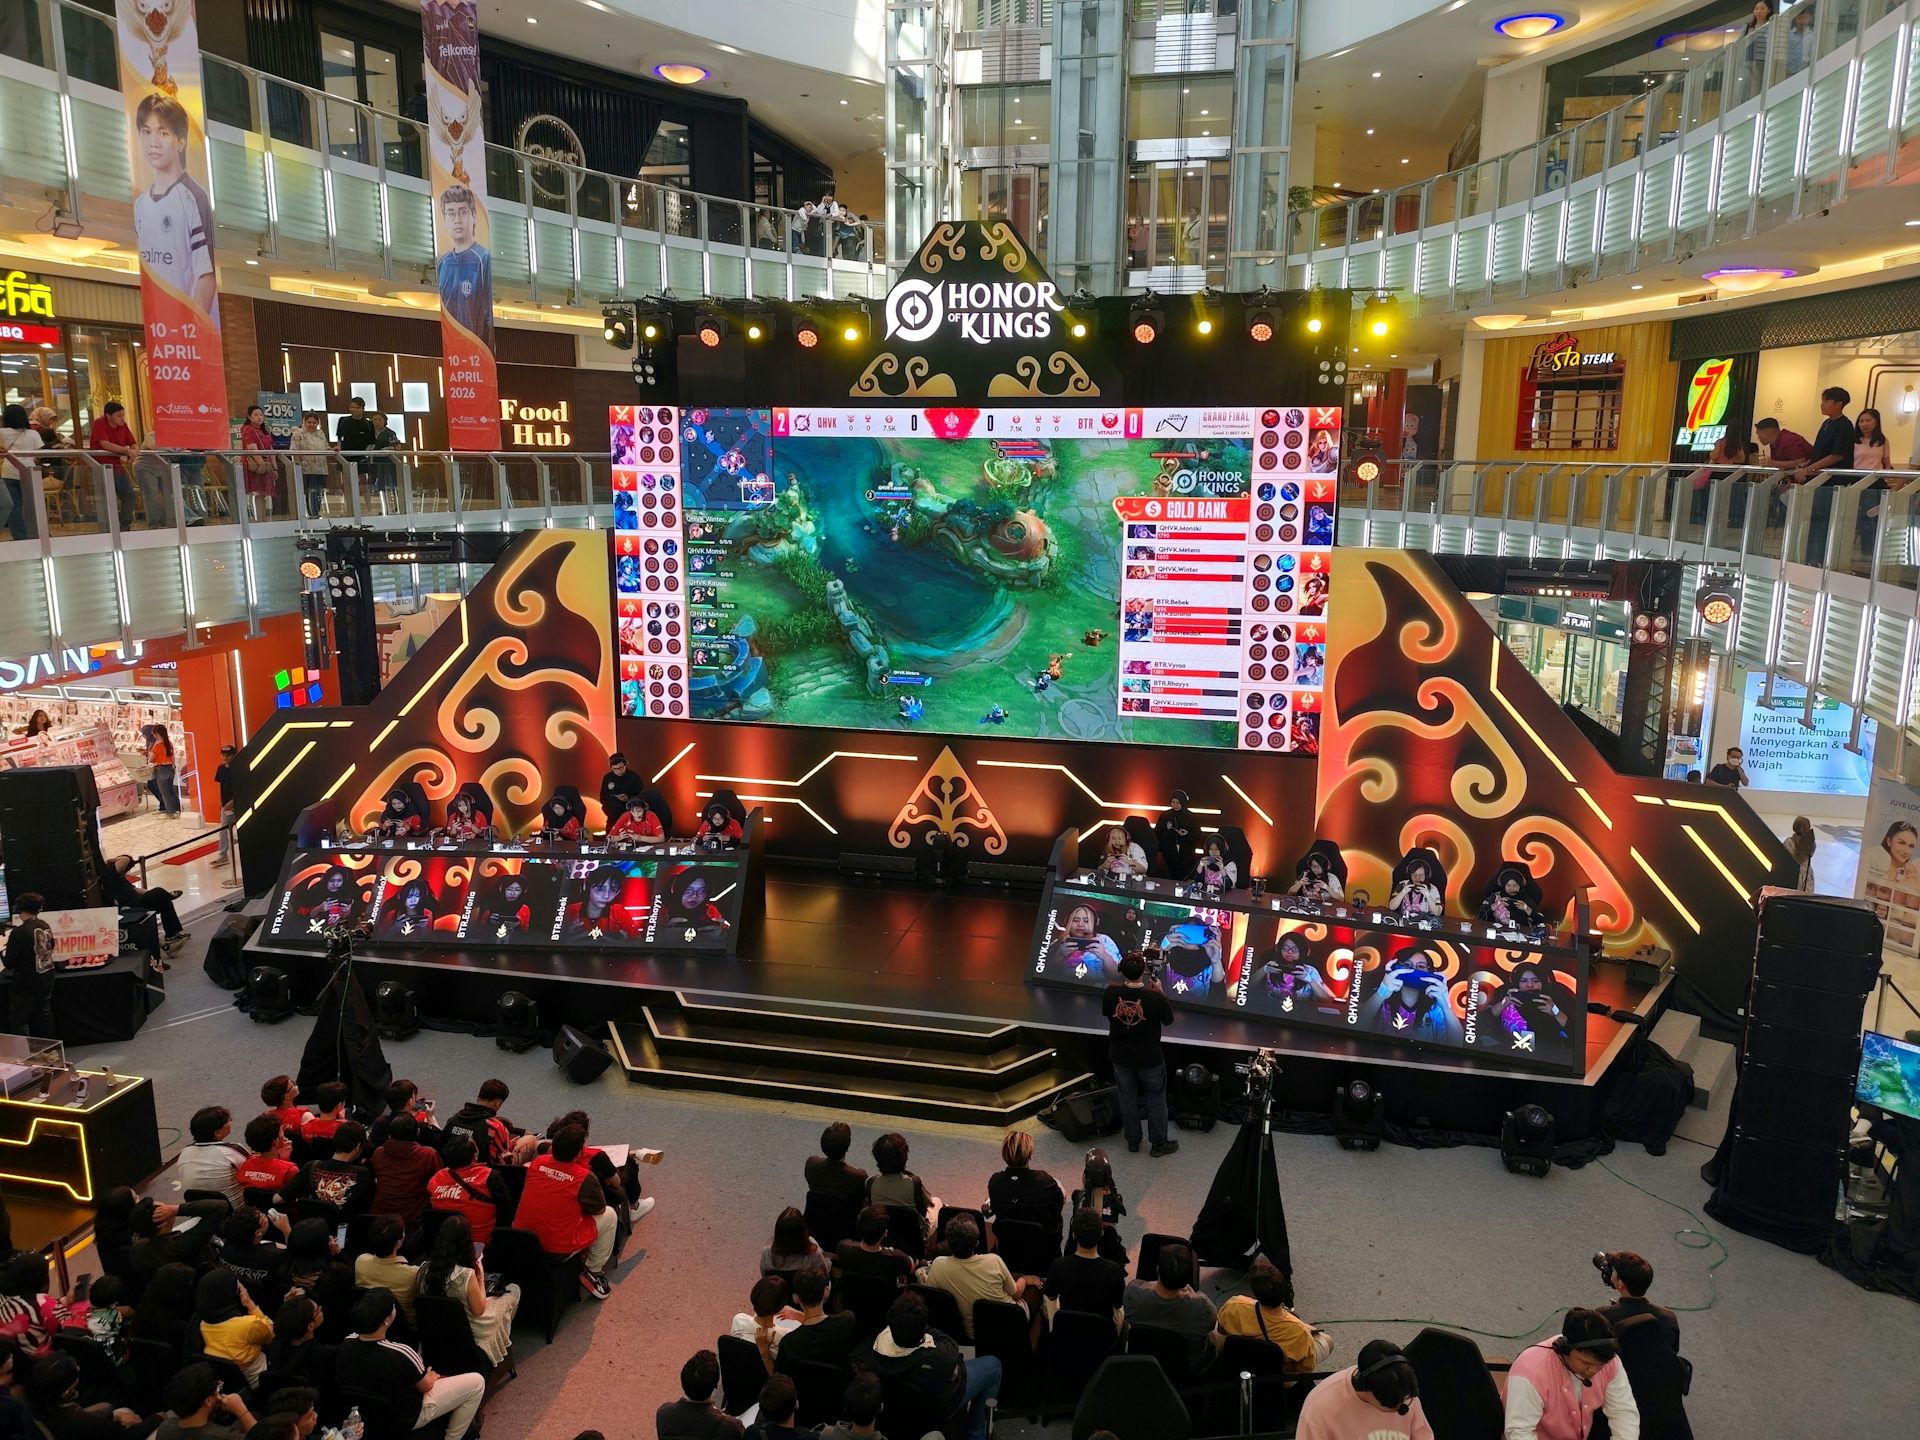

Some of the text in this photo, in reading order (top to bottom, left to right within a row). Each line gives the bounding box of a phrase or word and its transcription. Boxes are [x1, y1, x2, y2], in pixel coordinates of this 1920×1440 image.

[141, 248, 173, 265] ealme
[948, 282, 1065, 311] HONOR
[150, 323, 166, 338] 10
[181, 324, 197, 338] 12
[948, 312, 1051, 344] OF KINGS
[153, 344, 201, 360] APRIL
[448, 355, 459, 367] 10
[470, 356, 480, 367] 12
[1526, 342, 1615, 381] fiesta STEAK
[153, 365, 191, 380] 2026
[449, 371, 484, 383] APRIL
[450, 387, 476, 399] 2026
[499, 399, 569, 422] Food
[1203, 411, 1250, 421] GRAND FINAL
[777, 412, 786, 432] 2
[817, 417, 837, 428] QHVK
[911, 414, 918, 432] 0
[987, 414, 994, 432] 0
[1078, 417, 1094, 430] BTR
[511, 424, 571, 447] Hub
[1200, 471, 1245, 483] HONOR
[1202, 483, 1240, 494] KINGS
[1167, 501, 1228, 519] GOLD RANK
[1571, 618, 1592, 629] PLANT
[1786, 699, 1804, 707] Skin
[1752, 725, 1850, 739] Lembut Memban
[1750, 736, 1840, 749] Menyegarkan &
[1749, 748, 1829, 761] Melembabkan
[1748, 760, 1783, 771] Wajah
[368, 875, 388, 925] R.aavreedaX
[271, 891, 292, 934] BTR.Vyraa
[457, 891, 476, 938] BTR.Euforia
[551, 896, 568, 940] BTR.Bebek
[645, 894, 662, 943] BTR.Rhayys
[53, 935, 97, 954] AMPION
[1035, 909, 1058, 973] QHVK.Lavarein
[1236, 946, 1255, 1007] QHVK.Kiruuu
[1347, 960, 1364, 1024] QHVK.Monski
[1465, 979, 1480, 1044] QHVK.Winter
